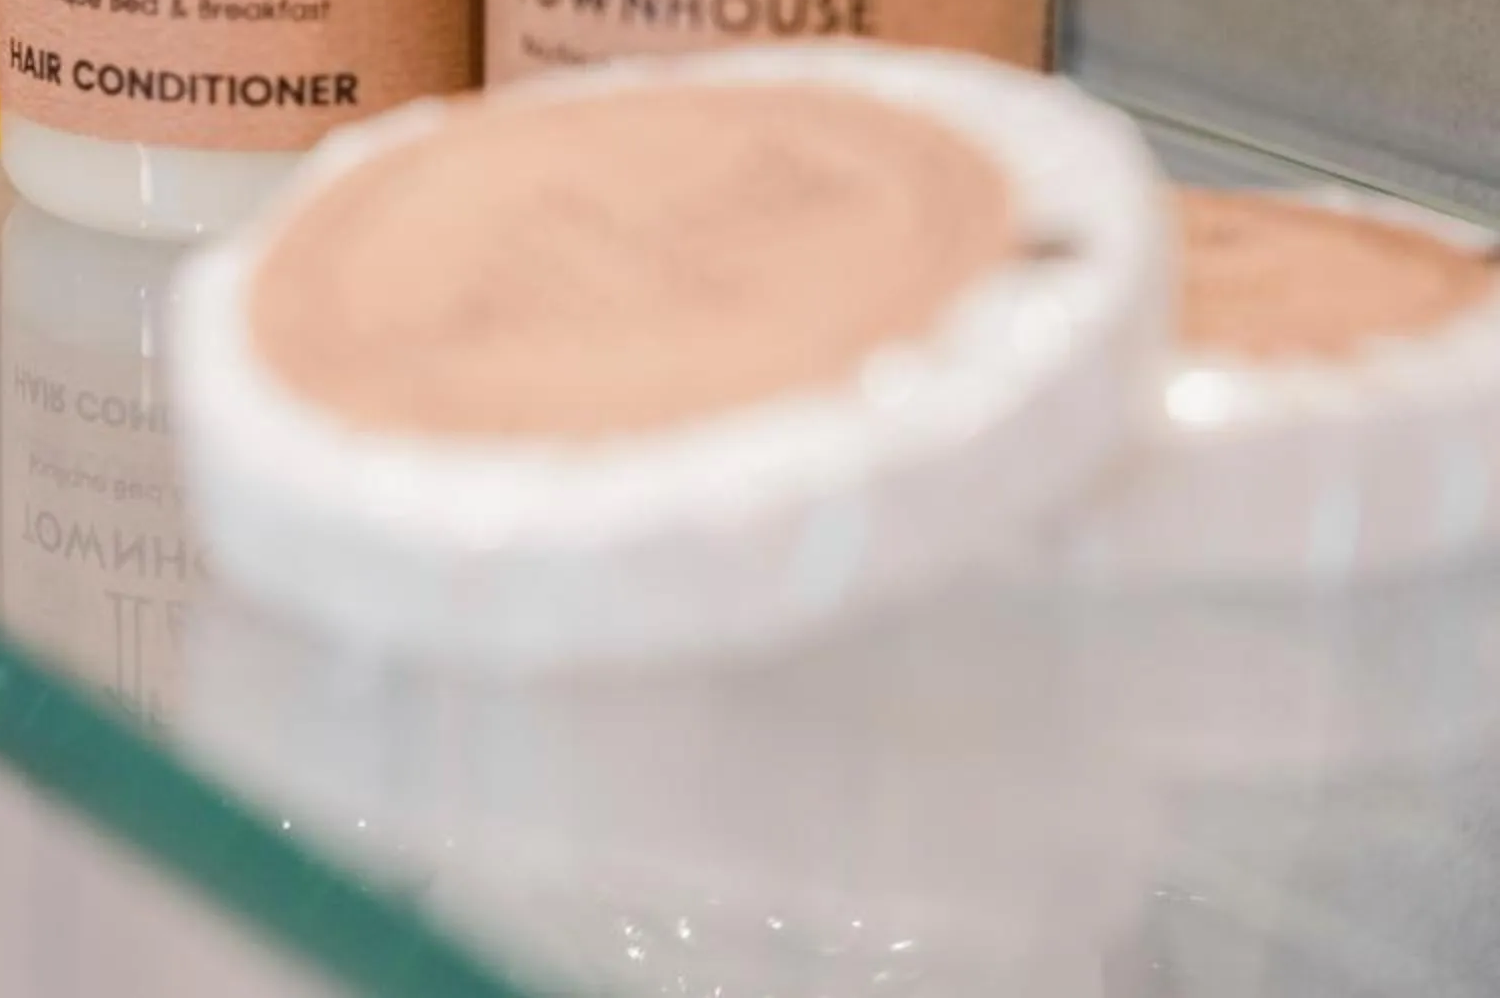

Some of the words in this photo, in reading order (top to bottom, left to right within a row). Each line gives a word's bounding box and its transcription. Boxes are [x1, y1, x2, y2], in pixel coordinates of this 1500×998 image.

[198, 0, 331, 23] Breakfast
[10, 36, 63, 85] HAIR
[72, 58, 360, 108] CONDITIONER
